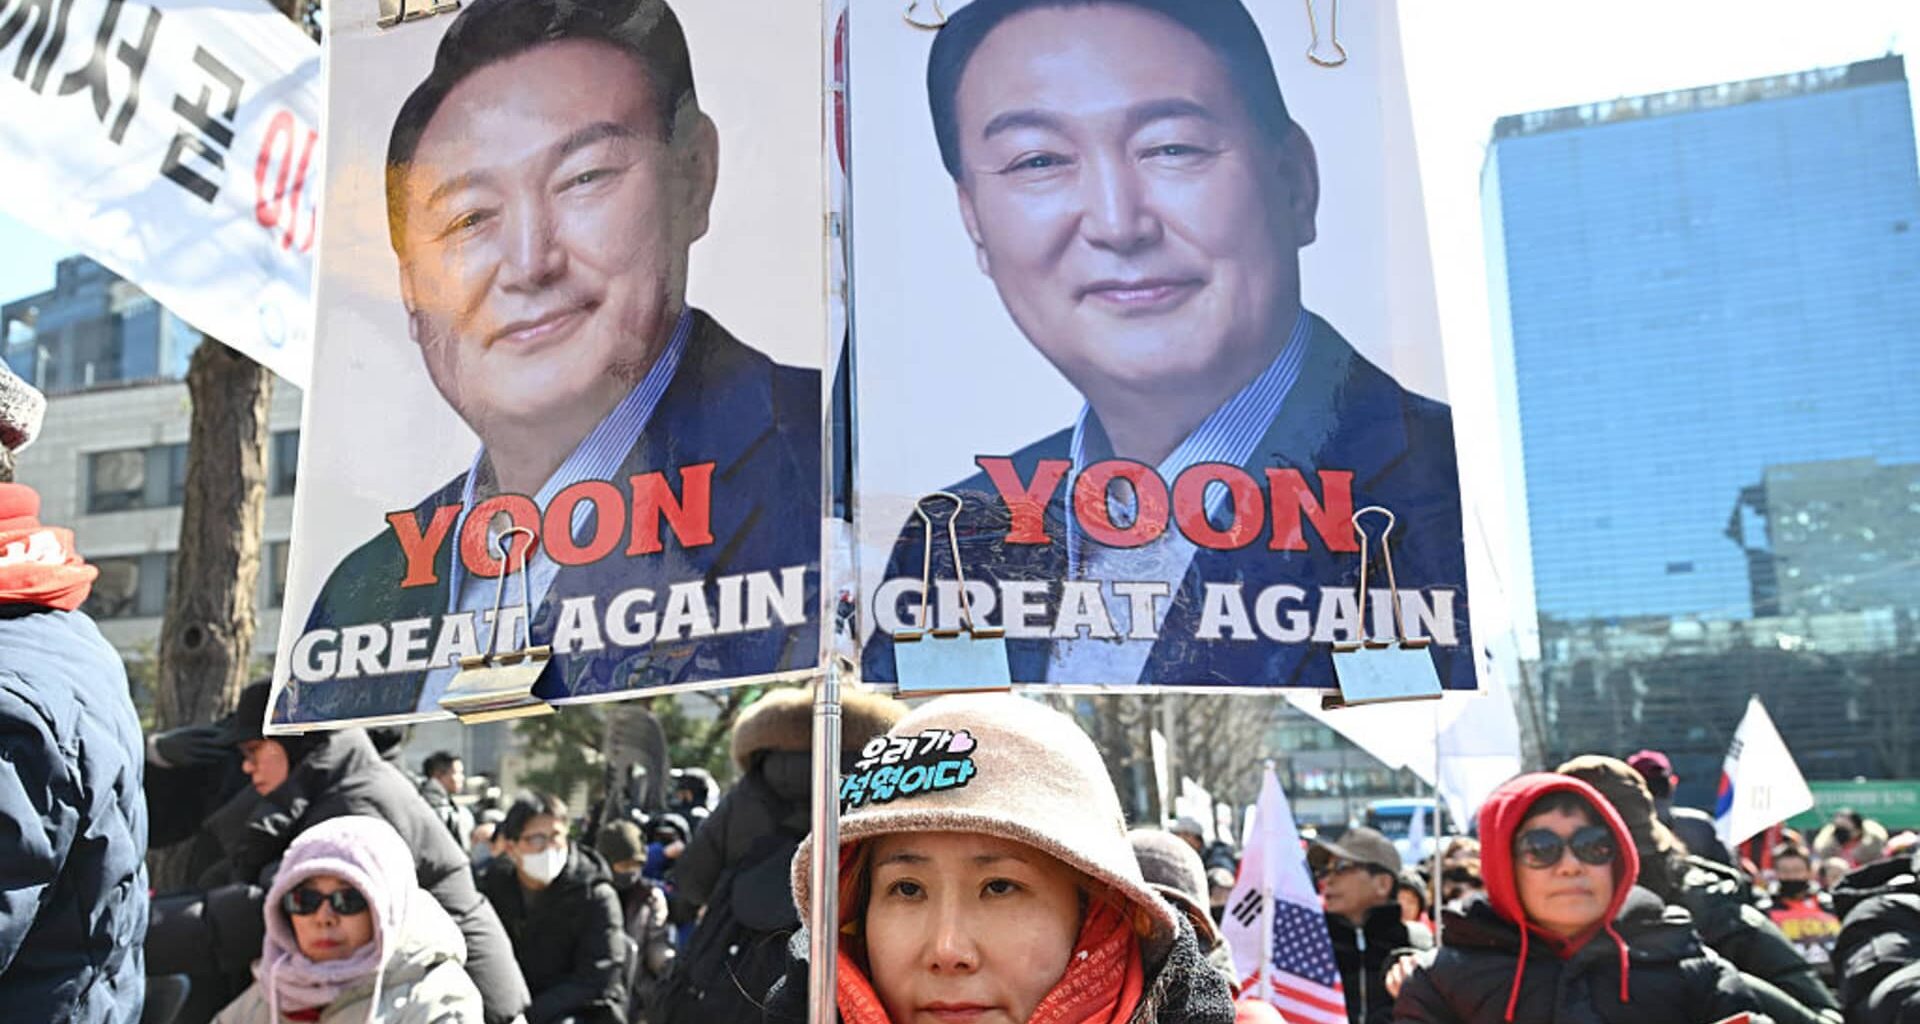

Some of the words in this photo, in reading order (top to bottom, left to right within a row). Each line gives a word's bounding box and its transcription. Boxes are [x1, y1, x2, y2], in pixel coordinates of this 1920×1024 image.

[385, 461, 716, 588] YOON
[975, 455, 1361, 553] YOON
[290, 605, 530, 683] GREAT
[551, 566, 808, 655] AGAIN
[873, 577, 1171, 642] GREAT
[1197, 582, 1458, 646] AGAIN
[840, 759, 975, 804] 석열이다
[854, 730, 953, 771] 우리가
